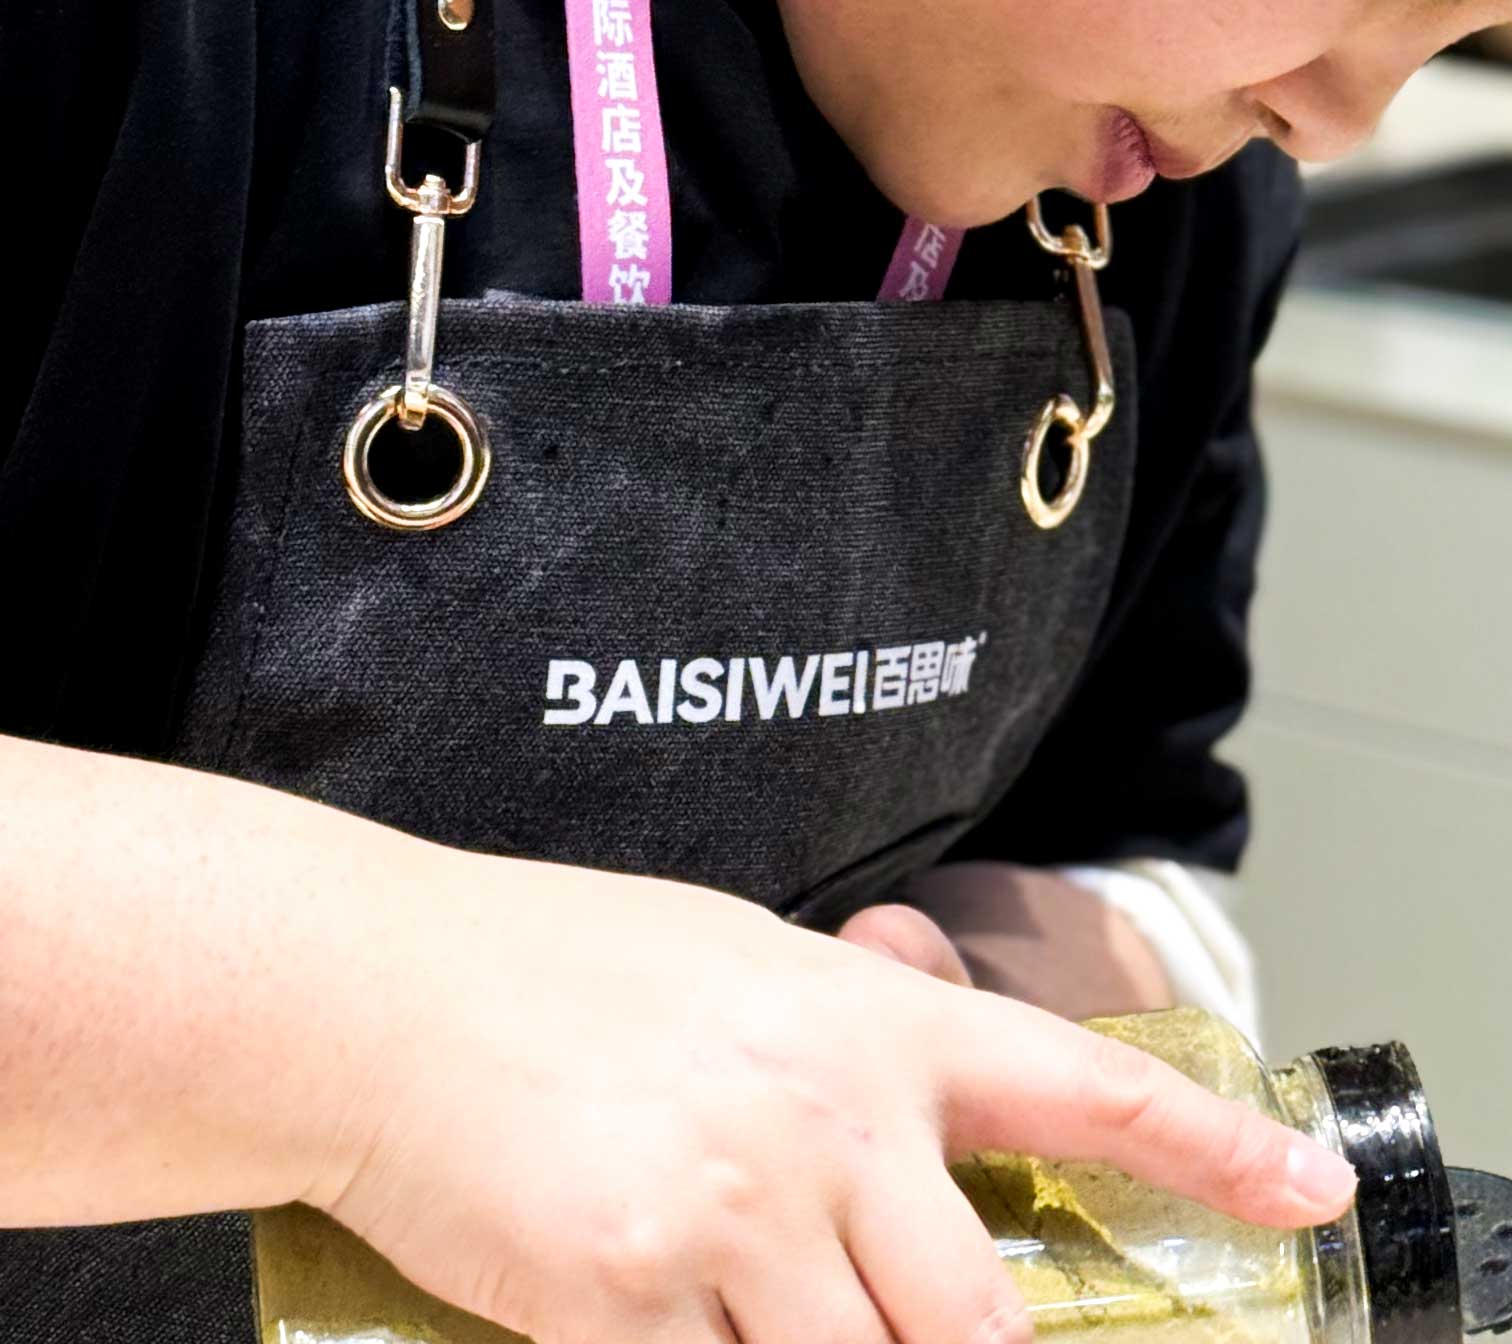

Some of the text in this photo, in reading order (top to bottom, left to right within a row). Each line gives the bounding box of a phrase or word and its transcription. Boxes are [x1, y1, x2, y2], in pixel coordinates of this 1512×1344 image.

[543, 635, 977, 725] BAISIWEI 百思味
